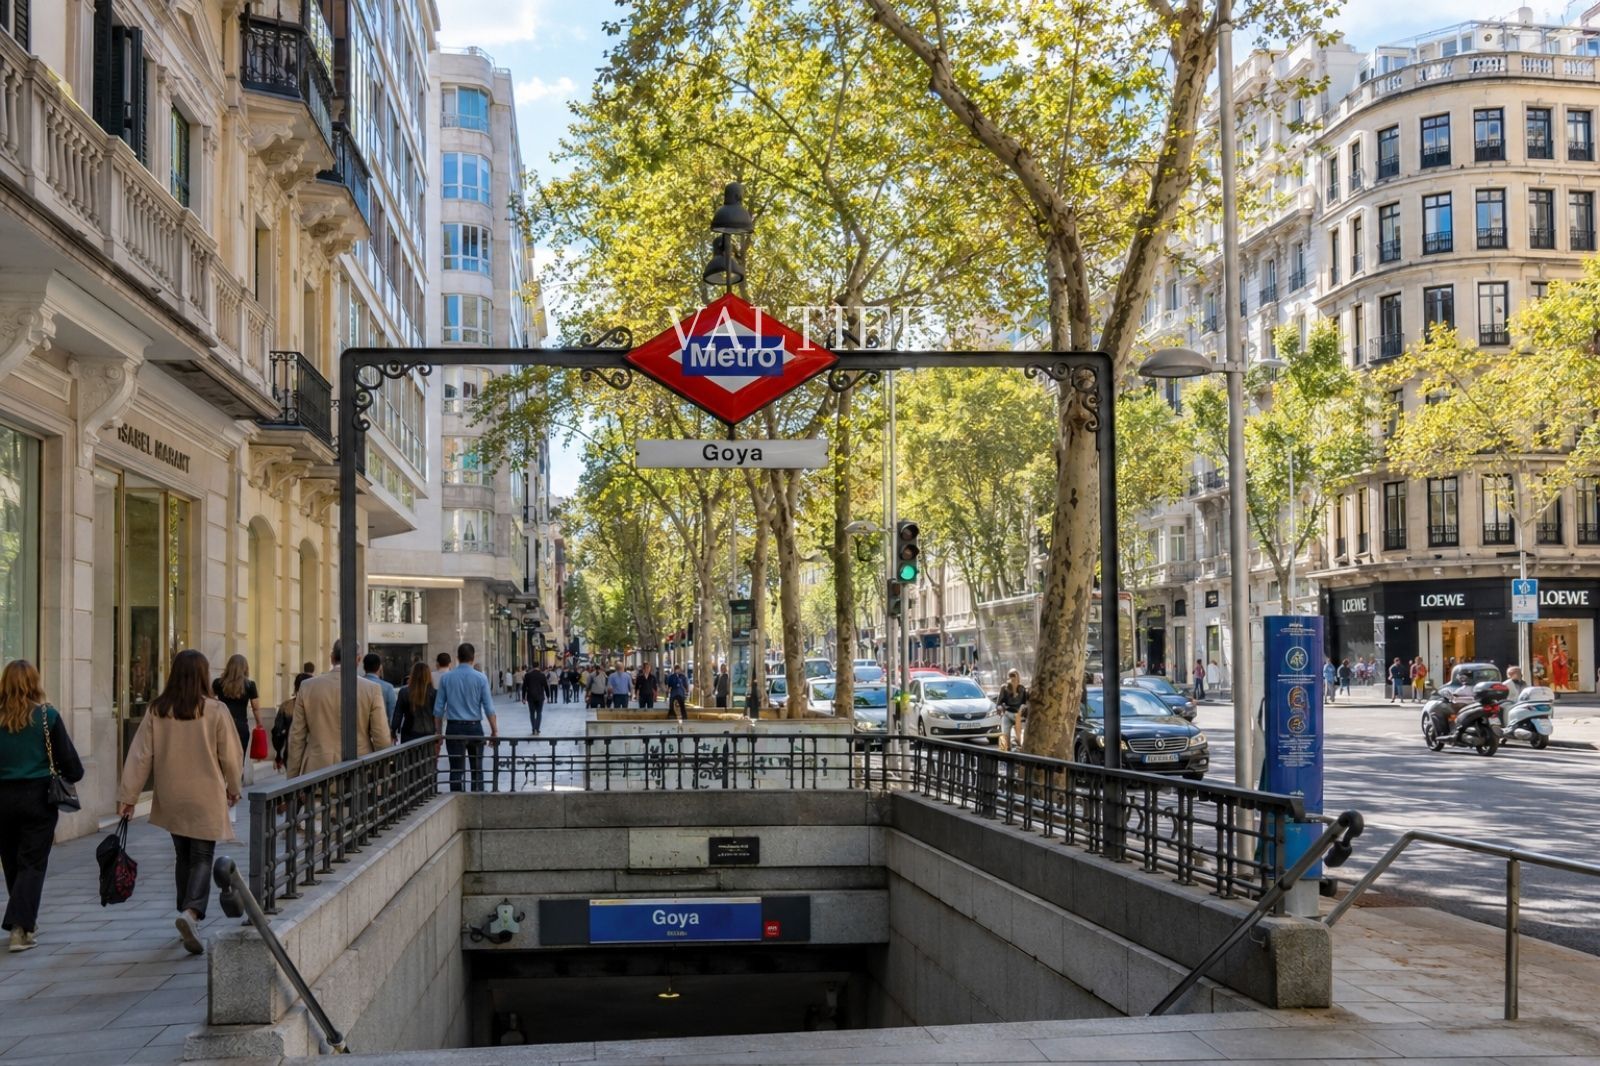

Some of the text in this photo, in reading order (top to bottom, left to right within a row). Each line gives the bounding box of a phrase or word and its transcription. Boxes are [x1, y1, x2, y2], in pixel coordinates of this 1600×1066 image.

[690, 342, 777, 368] Metro
[117, 422, 191, 474] ISABEL MARANT
[702, 444, 763, 466] Goya
[1342, 597, 1367, 613] LOEWE
[1420, 593, 1465, 608] LOEWE
[1539, 589, 1590, 606] LOEWE
[652, 909, 700, 928] Goya
